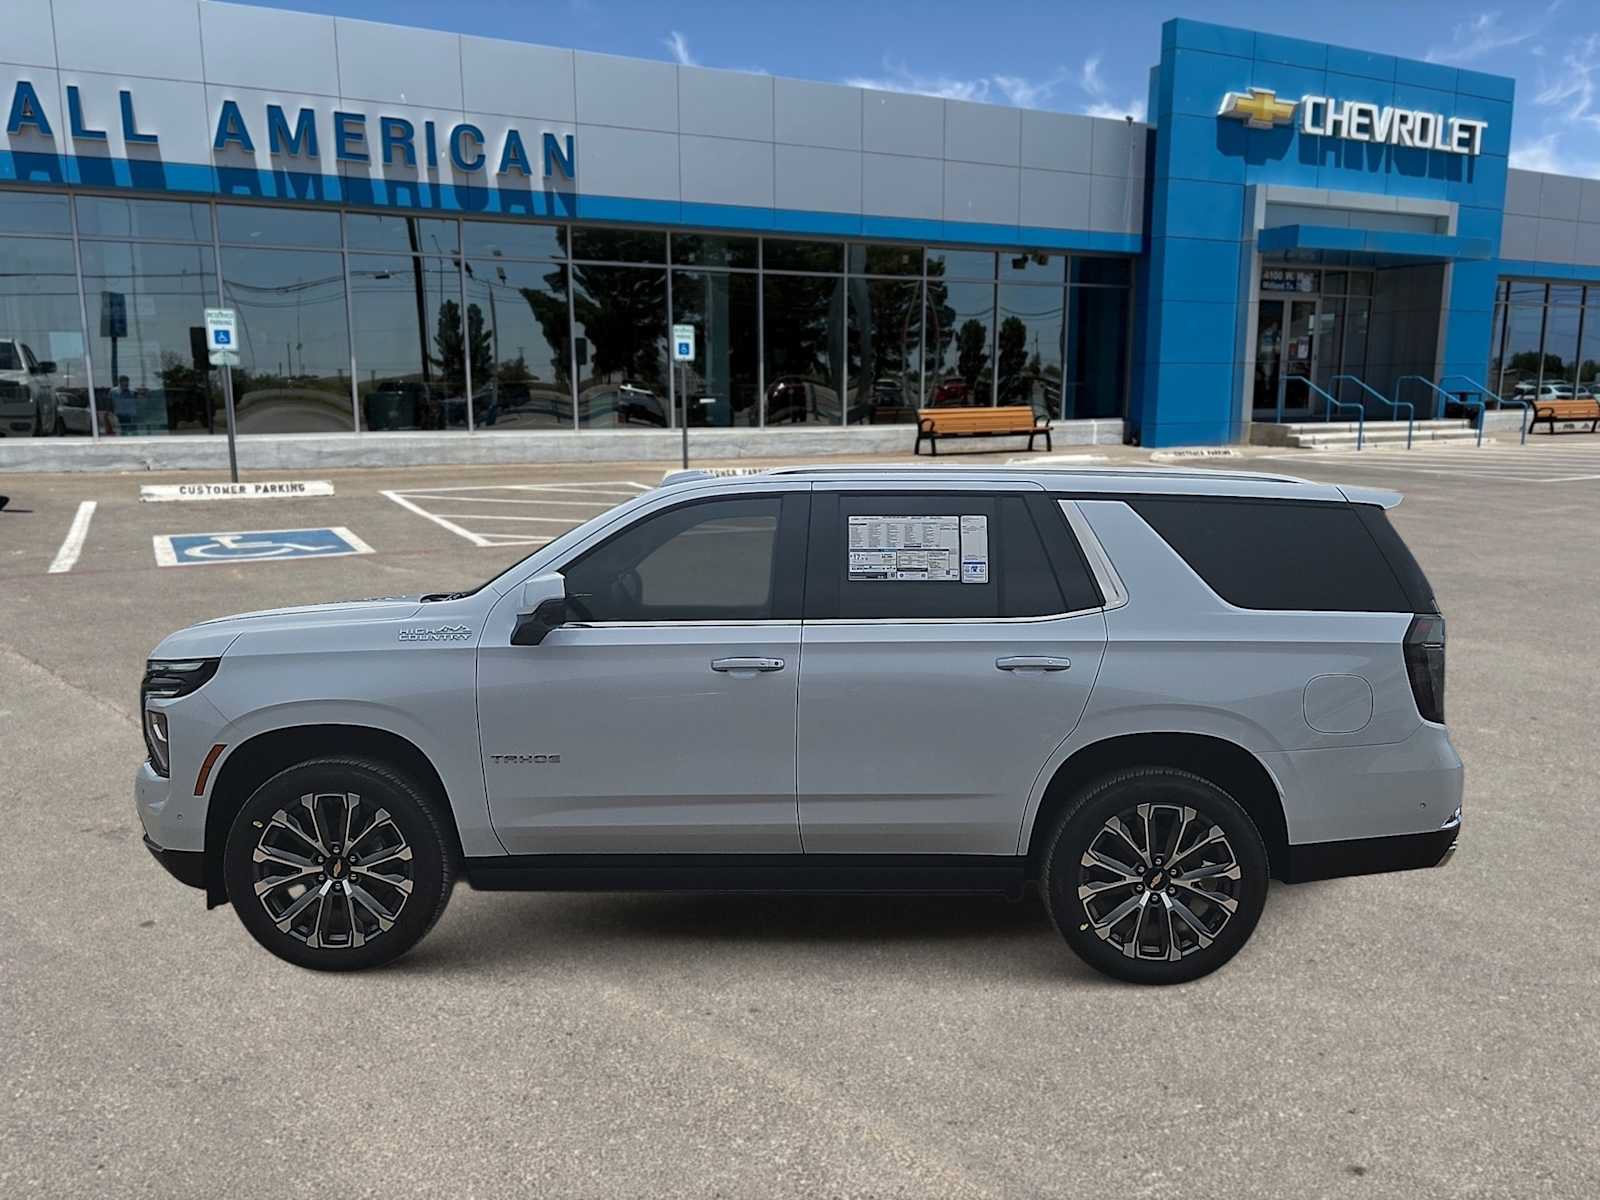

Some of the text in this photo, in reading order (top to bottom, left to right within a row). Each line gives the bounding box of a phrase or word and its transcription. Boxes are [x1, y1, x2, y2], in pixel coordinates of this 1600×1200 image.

[6, 79, 576, 179] ALL AMERICAN
[1301, 93, 1488, 155] CHEVROLET
[179, 483, 306, 496] CUSTOMER PARKING
[399, 627, 435, 635] HIGH
[399, 634, 473, 642] COUNTRY
[490, 754, 561, 764] TAHOE
